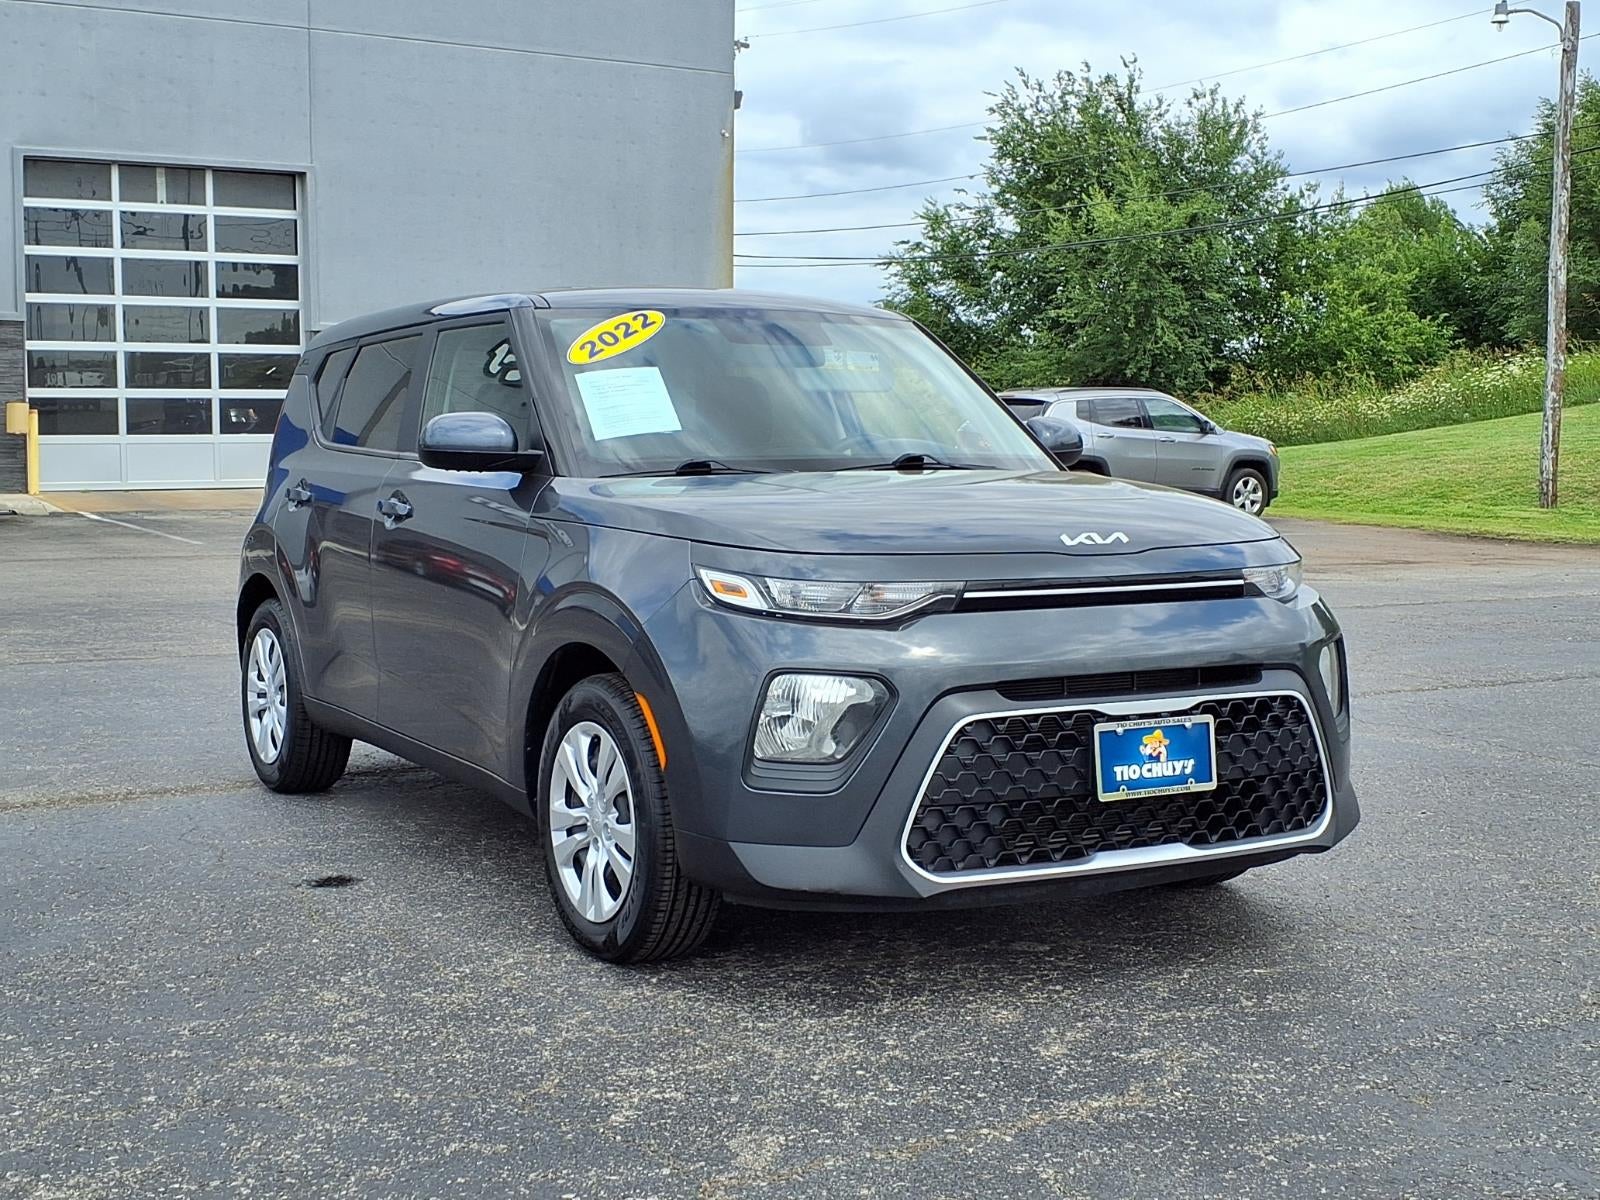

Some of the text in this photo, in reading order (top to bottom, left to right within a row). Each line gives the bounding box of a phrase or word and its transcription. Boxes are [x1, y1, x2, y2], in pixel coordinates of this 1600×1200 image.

[579, 312, 657, 360] 2022
[1060, 532, 1129, 546] KIA
[1128, 720, 1152, 728] CHUY'S
[1172, 716, 1192, 724] SALES
[1113, 758, 1195, 781] TIO CHUY'S
